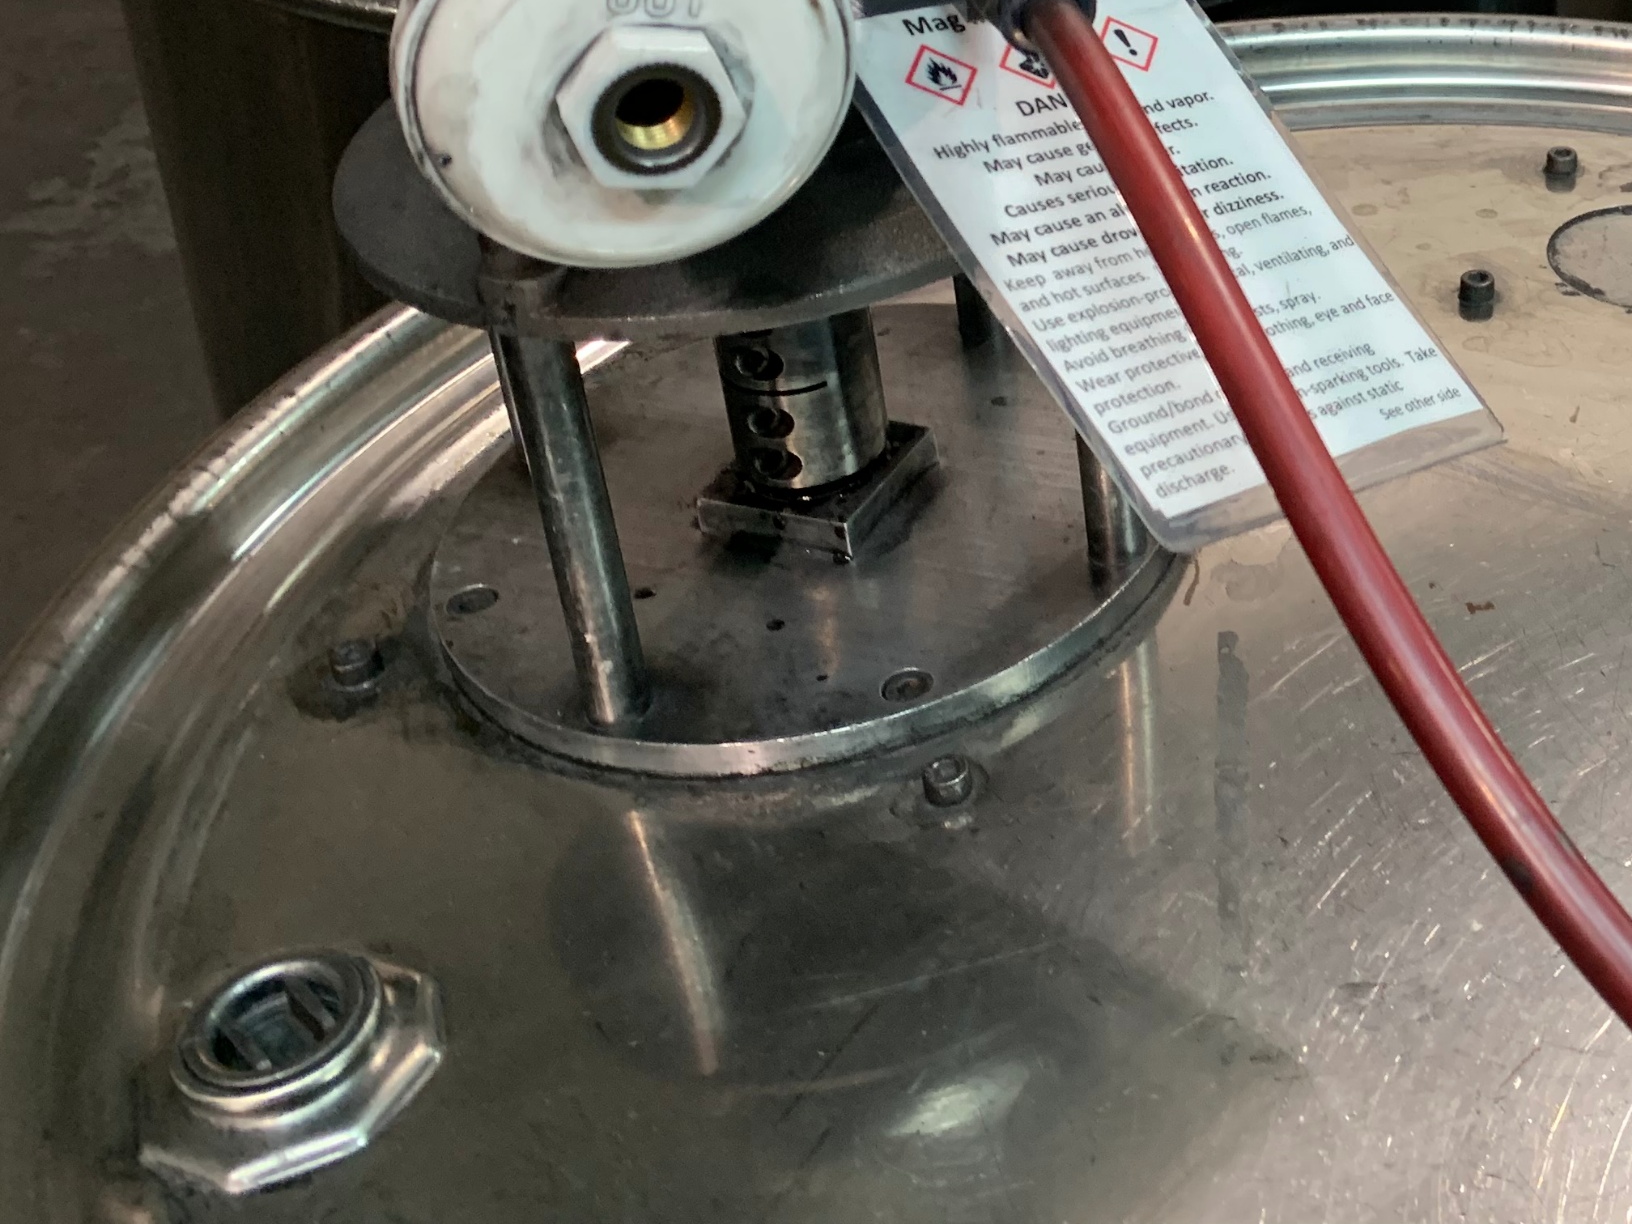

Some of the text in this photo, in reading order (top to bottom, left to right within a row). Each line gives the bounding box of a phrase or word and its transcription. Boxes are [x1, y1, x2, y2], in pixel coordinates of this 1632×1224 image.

[902, 14, 967, 36] Mag
[933, 91, 1214, 159] Highly flammable nd vapor.
[1015, 93, 1068, 116] DAN
[982, 158, 1023, 174] May
[1026, 146, 1074, 164] cause
[1153, 116, 1198, 135] fects.
[1034, 162, 1104, 186] May cau
[990, 231, 1031, 246] May
[1034, 216, 1083, 236] cause
[1084, 212, 1107, 225] an
[1205, 170, 1271, 193] reaction.
[1004, 196, 1065, 218] Causes
[1006, 250, 1048, 267] May
[1050, 237, 1098, 257] cause
[1213, 190, 1284, 216] dizziness.
[1003, 275, 1047, 292] Keep
[1052, 262, 1094, 281] away
[1094, 251, 1133, 269] from
[1226, 219, 1262, 237] open
[1262, 205, 1312, 225] flames,
[1019, 271, 1149, 313] and hot surfaces.
[1031, 316, 1065, 332] Use
[1067, 287, 1170, 321] explosion-pro
[1254, 244, 1330, 273] ventilating,
[1330, 235, 1355, 251] and
[1045, 307, 1181, 353] lighting equipme
[1064, 290, 1322, 373] Avoid breathing sts, spray.
[1076, 290, 1395, 393] Wear protective othing, eye and face
[1093, 379, 1181, 417] protection.
[1107, 391, 1214, 434] Ground/bond
[1313, 343, 1376, 369] receiving
[1124, 346, 1438, 456] equipment. Us n-sparking tools. Take
[1317, 394, 1367, 417] against
[1367, 380, 1404, 400] static
[1379, 385, 1462, 421] See other side
[1155, 464, 1235, 498] discharge.
